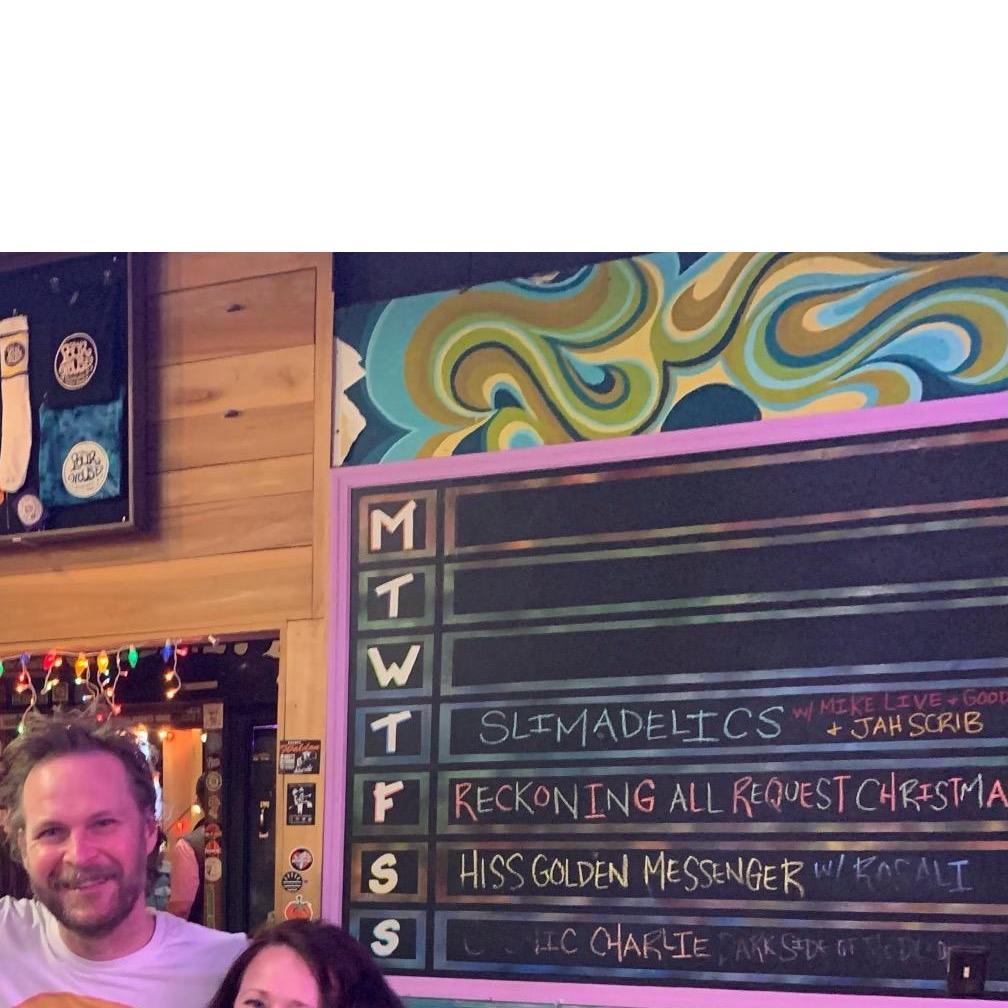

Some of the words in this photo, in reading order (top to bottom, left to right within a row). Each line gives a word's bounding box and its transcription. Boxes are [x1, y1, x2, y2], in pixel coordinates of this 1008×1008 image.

[371, 500, 417, 550] M
[375, 573, 414, 618] T
[368, 645, 421, 687] W
[820, 695, 875, 716] MIKE
[884, 691, 942, 711] LIVE
[370, 710, 412, 753] T
[479, 706, 785, 748] SLIMADELICS
[851, 714, 901, 739] JAH
[908, 711, 984, 738] SCRIB
[373, 780, 404, 823] F
[455, 778, 656, 822] RECKONING
[669, 782, 724, 814] ALL
[733, 775, 851, 818] REQUEST
[856, 771, 1008, 813] CHRISTMA
[368, 853, 399, 894] S
[459, 849, 525, 890] HISS
[532, 852, 629, 890] GOLDEN
[644, 851, 805, 898] MESSENGER
[370, 918, 400, 957] S
[589, 922, 713, 963] CHARLIE
